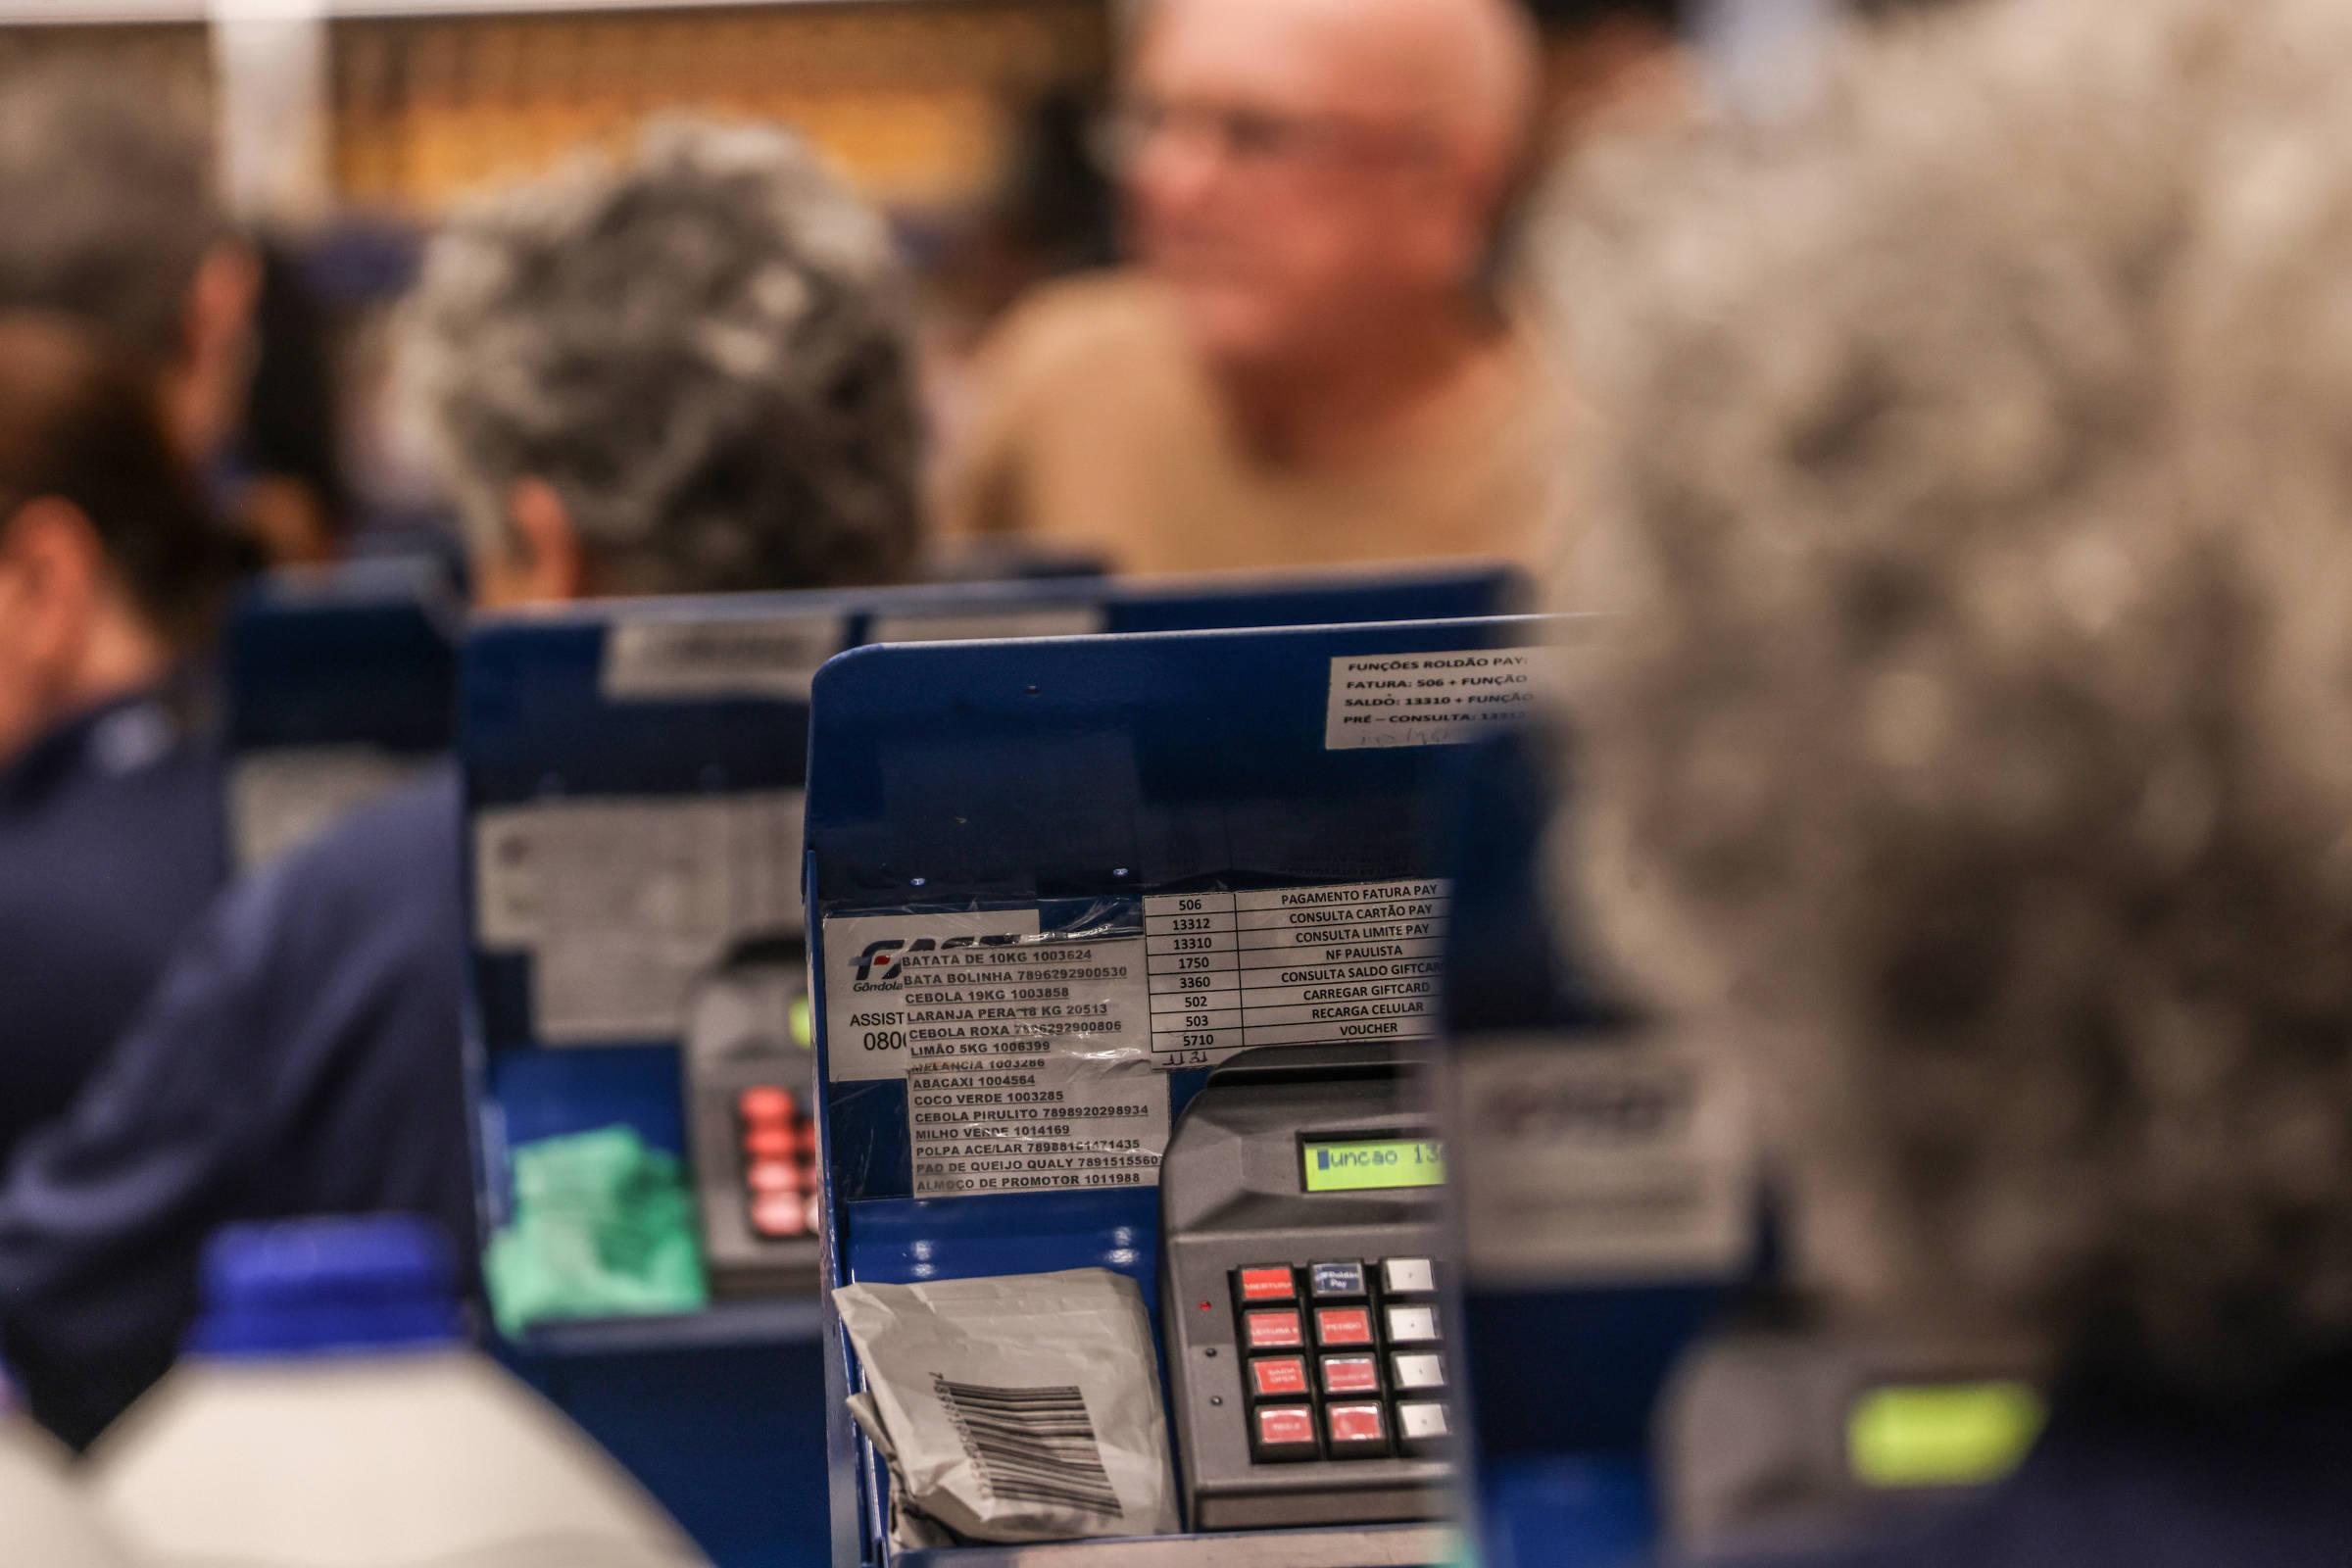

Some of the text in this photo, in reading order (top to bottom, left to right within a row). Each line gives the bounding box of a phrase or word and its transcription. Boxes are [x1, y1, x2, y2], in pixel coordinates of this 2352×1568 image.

[1348, 660, 1419, 672] FUNÇÕES
[1424, 657, 1489, 669] ROLDÃO
[1347, 679, 1413, 689] FATURA:
[1417, 678, 1444, 687] 506
[1461, 673, 1528, 686] FUNÇÃO
[1405, 696, 1450, 706] 13310
[1344, 712, 1371, 723] PRÉ
[1389, 712, 1476, 723] CONSULTA:
[1178, 884, 1438, 911] 506 PAGAMENTO FATURA PAY
[1172, 904, 1433, 931] 13312 CONSULTA CARTÃO PAY
[1173, 923, 1430, 951] 13310 CONSULTA LIMITE PAY
[902, 950, 1092, 967] BATATA DE 10KG 1003624
[1178, 945, 1403, 969] 1750 NF PAULISTA
[904, 966, 1127, 986] BATA BOLINHA 7896292900530
[1179, 961, 1445, 989] 3360 CONSULTA SALDO GIFTCAR
[853, 981, 904, 992] Gôndola
[1185, 982, 1430, 1008] 502 CARREGAR GIFTCARD
[905, 987, 1069, 1004] CEBOLA 19KG 1003858
[906, 1009, 973, 1022] LARANJA
[978, 1006, 1015, 1019] PERA
[1042, 1005, 1061, 1016] KG
[1066, 1004, 1107, 1015] 20513
[1186, 1001, 1425, 1028] 503 RECARGA CELULAR
[909, 1025, 966, 1039] CEBOLA
[970, 1025, 1010, 1037] ROXA
[1182, 1022, 1398, 1047] 5710 VOUCHER
[910, 1041, 1051, 1056] LIMÃO 5KG 1006399
[913, 1077, 973, 1089] ABACAXI
[914, 1090, 1063, 1105] COCO VERDE 1003285
[915, 1111, 969, 1123] CEBOLA
[973, 1108, 1038, 1120] PIRULITO
[915, 1128, 958, 1140] MILHO
[964, 1126, 1008, 1138] VERDE
[916, 1146, 959, 1156] POLPA
[964, 1144, 1022, 1155] ACE/LAR
[949, 1161, 966, 1172] DE
[971, 1159, 1022, 1172] QUEIJO
[1027, 1157, 1074, 1169] QUALY
[1078, 1154, 1162, 1167] 7891515560
[1318, 1149, 1397, 1170] uncao
[917, 1173, 1140, 1192] ALMOÇO DE PROMOTOR 1011988
